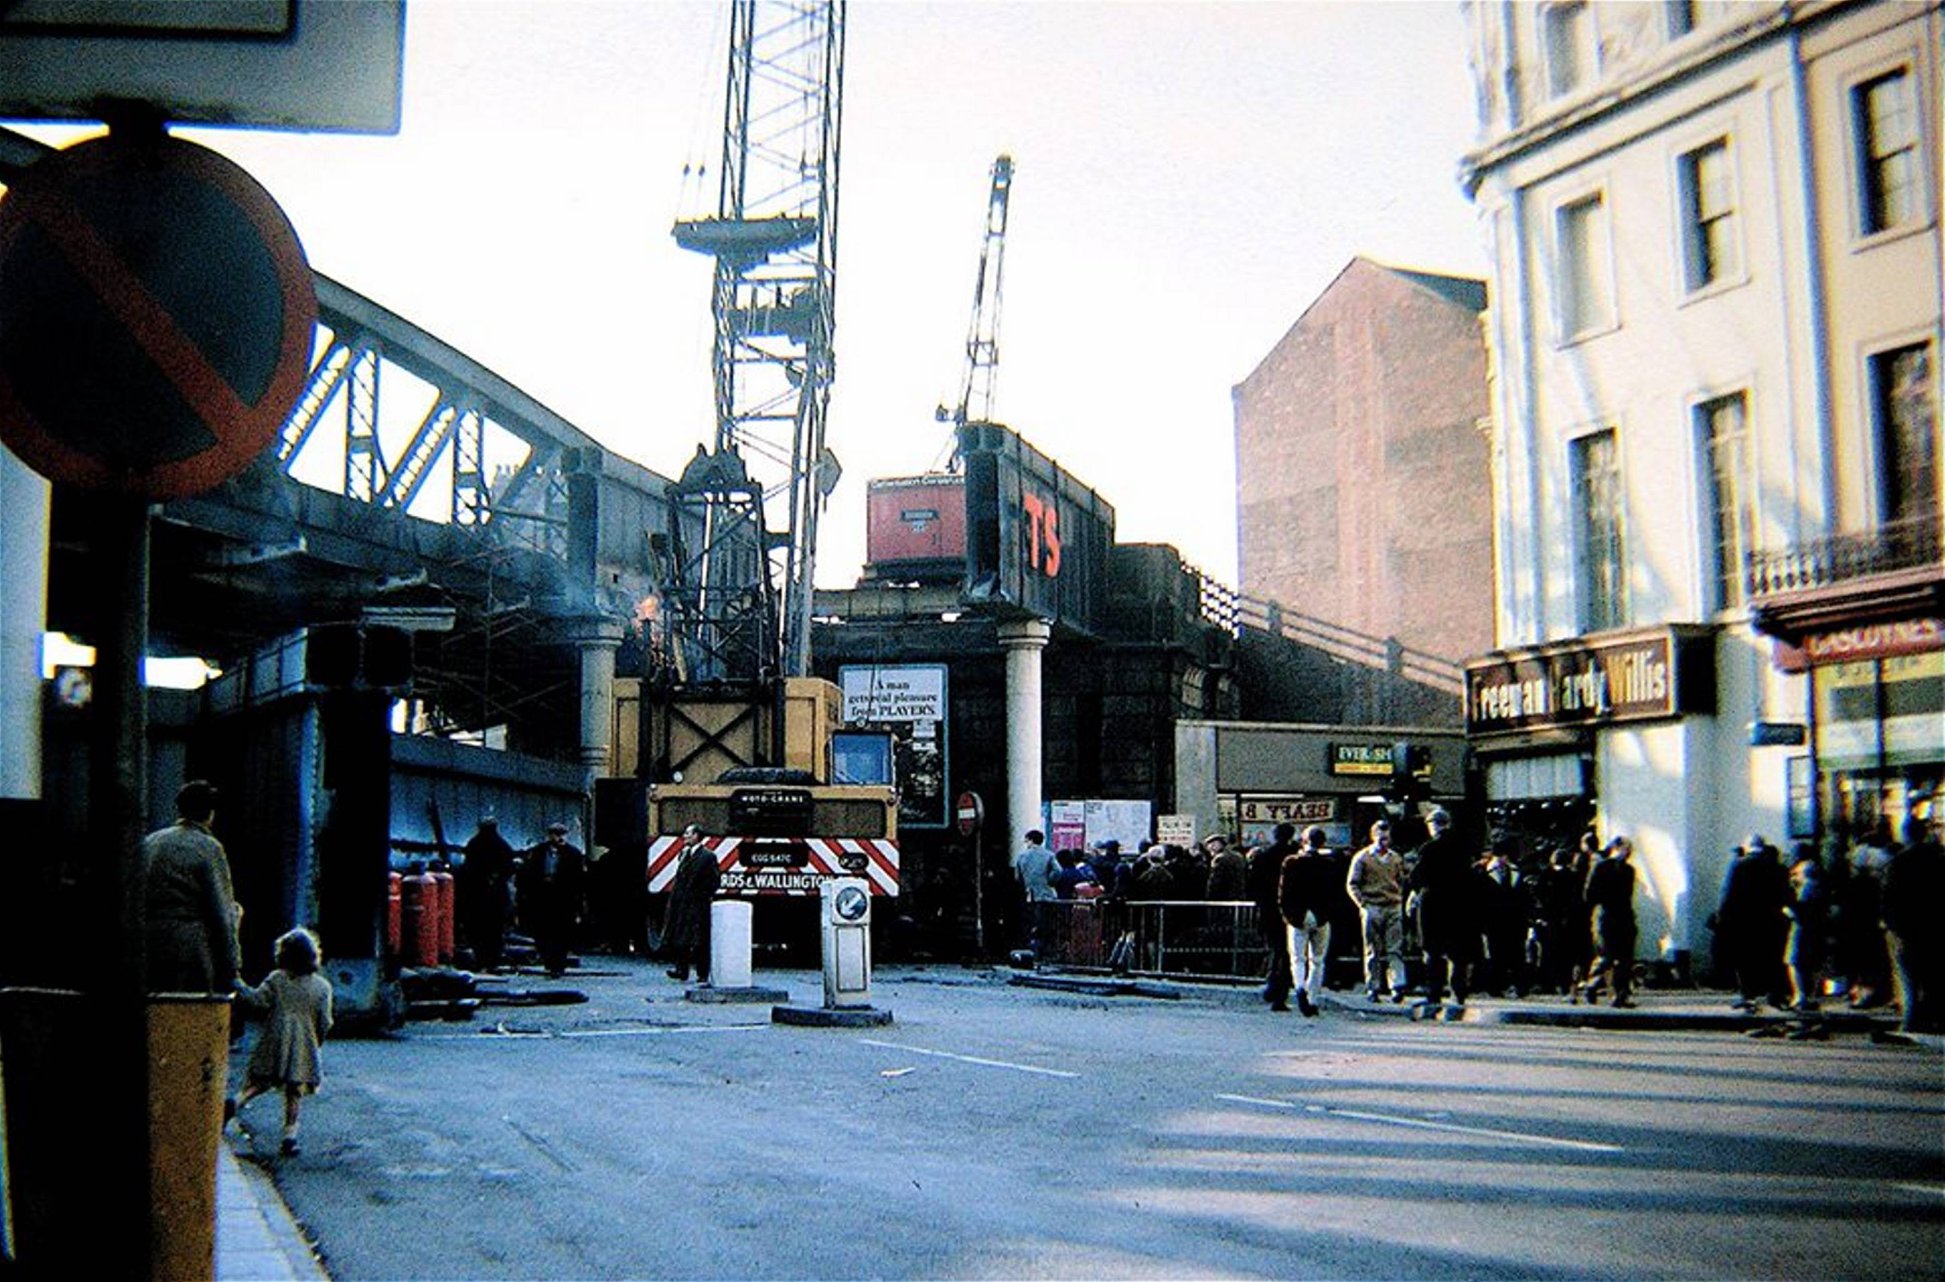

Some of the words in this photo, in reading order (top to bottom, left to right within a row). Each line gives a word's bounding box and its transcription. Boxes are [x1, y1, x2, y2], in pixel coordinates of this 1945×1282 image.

[1022, 493, 1061, 577] TS
[1606, 650, 1666, 704] Willis
[886, 682, 910, 690] man
[893, 692, 937, 703] pleasure
[720, 875, 746, 888] RDS
